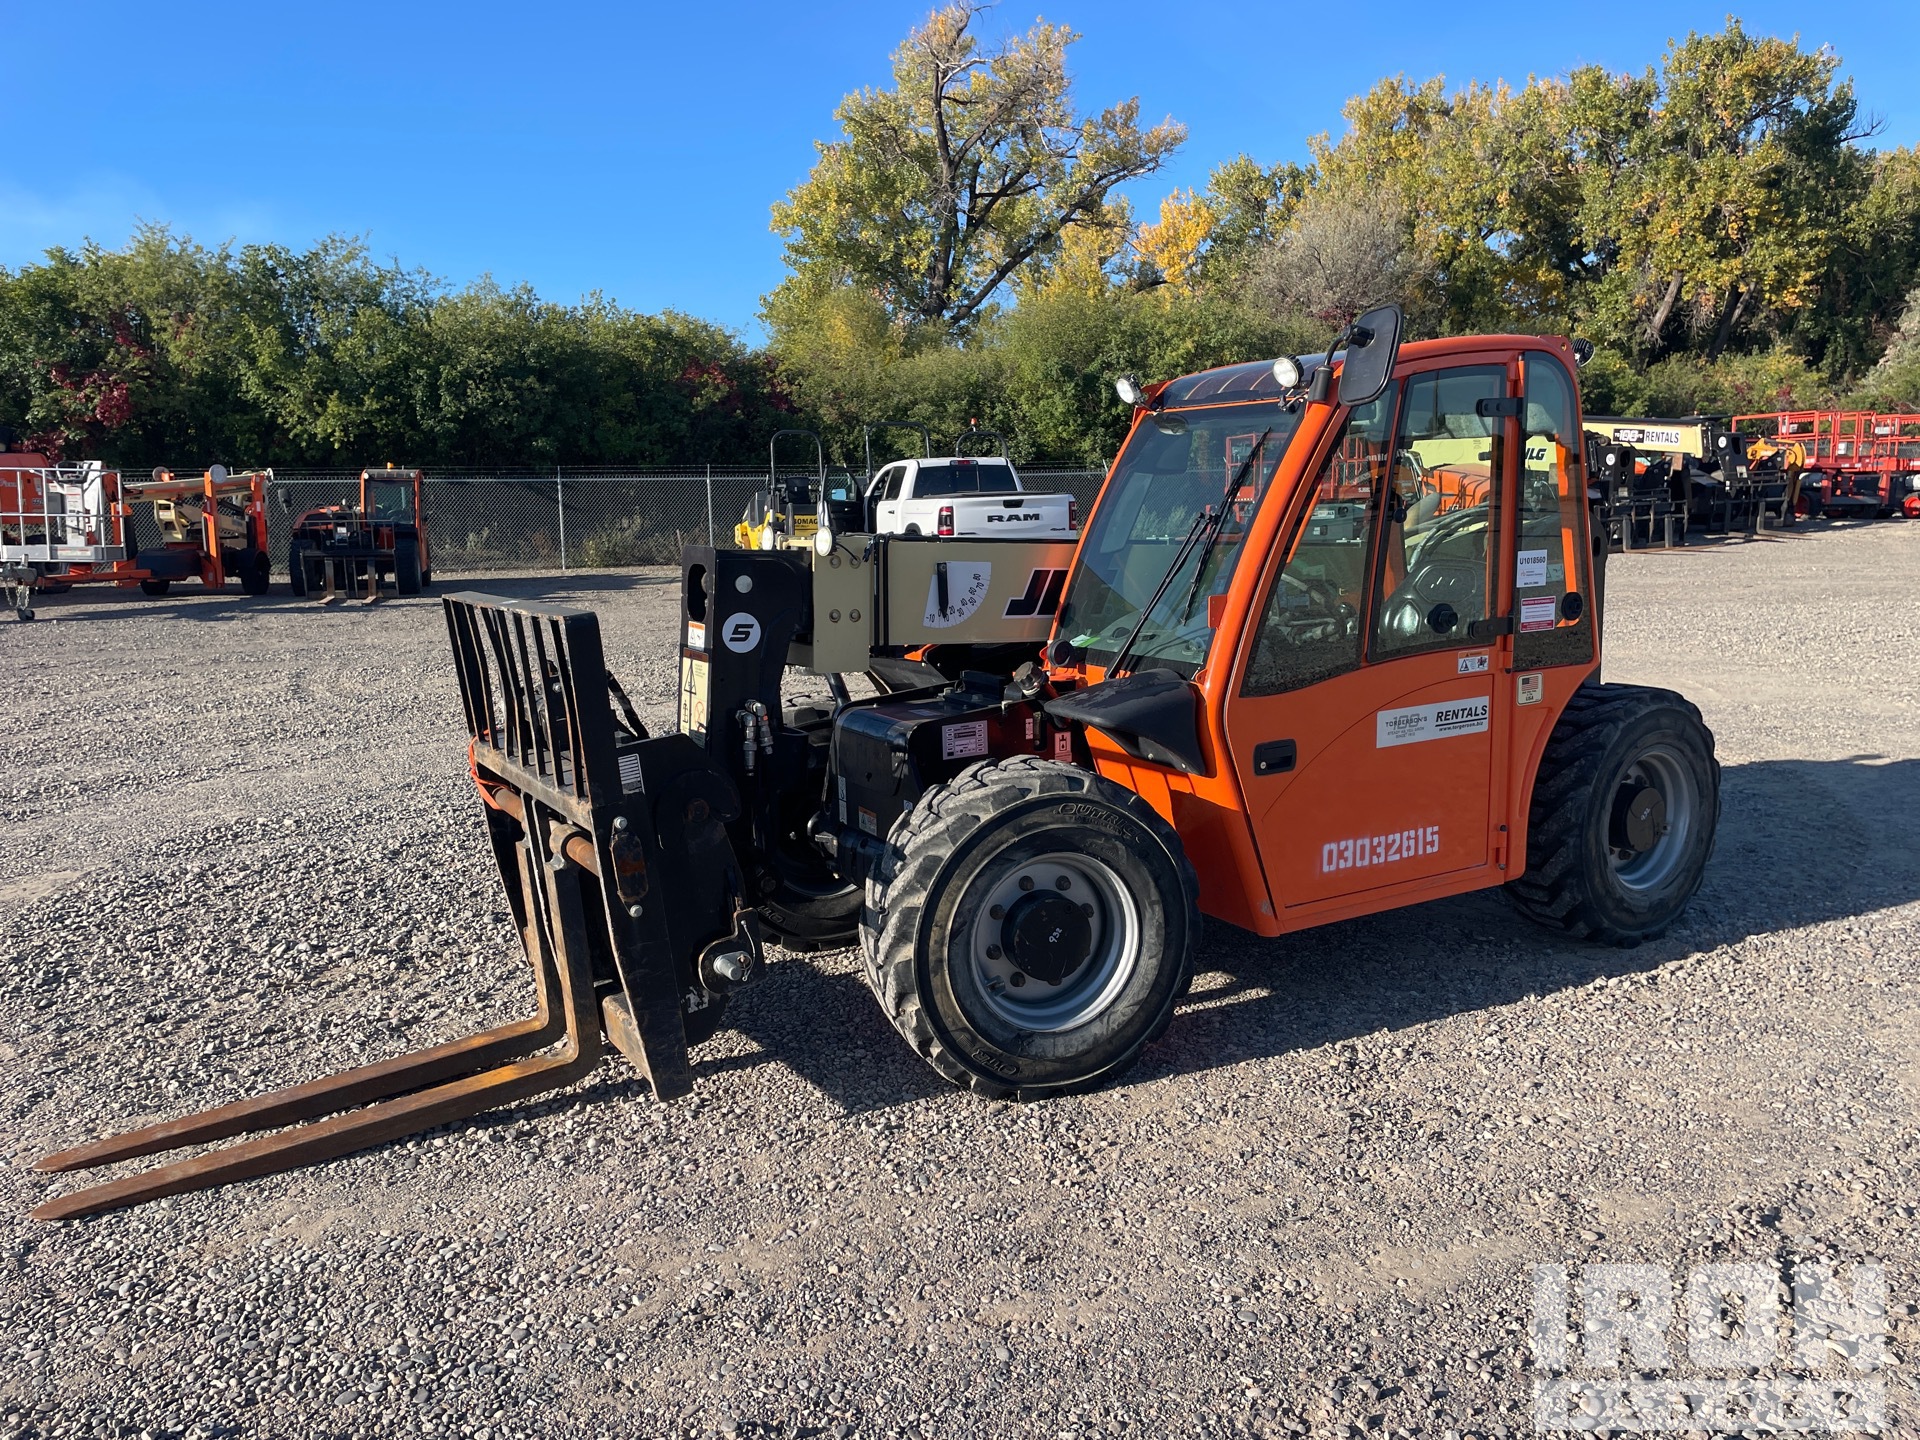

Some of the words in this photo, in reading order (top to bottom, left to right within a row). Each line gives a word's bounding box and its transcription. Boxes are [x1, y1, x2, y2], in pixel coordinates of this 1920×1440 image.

[1645, 431, 1680, 444] RENTALS
[987, 513, 1041, 523] RAM
[1520, 556, 1546, 564] U1018560
[972, 573, 981, 581] 80
[968, 586, 977, 595] 60
[976, 581, 984, 590] 70
[949, 605, 955, 615] 20
[729, 624, 754, 642] 5
[1435, 705, 1488, 722] RENTALS
[1438, 721, 1484, 732] www.torgerson.biz
[1322, 825, 1440, 873] 03032615
[1048, 927, 1063, 943] 932
